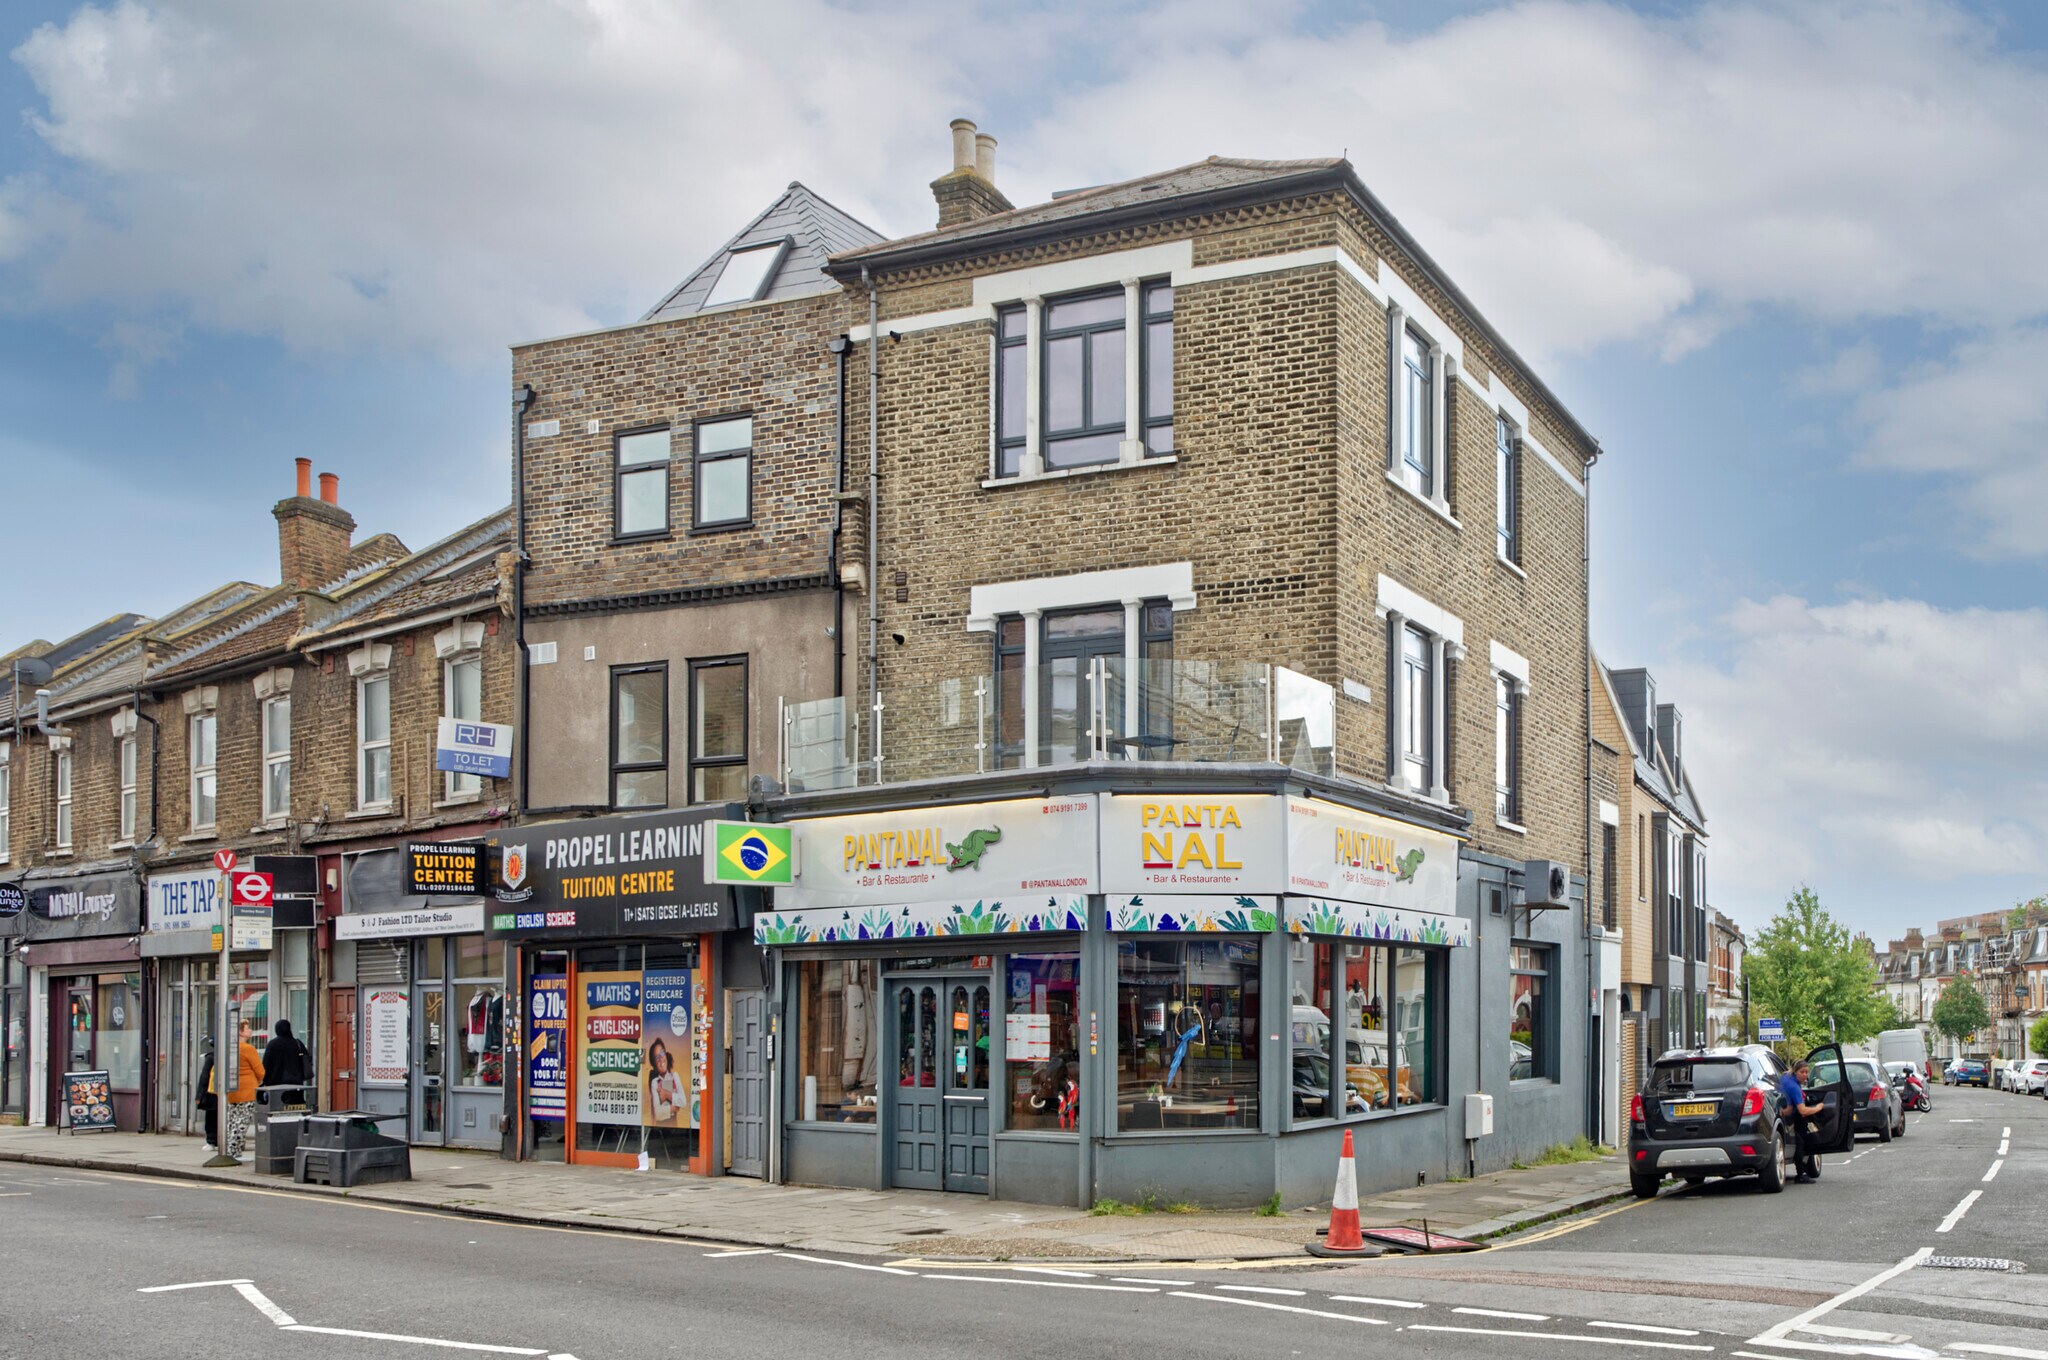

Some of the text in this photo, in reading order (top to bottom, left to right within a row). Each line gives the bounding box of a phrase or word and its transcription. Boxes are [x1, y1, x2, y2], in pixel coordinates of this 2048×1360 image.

[458, 725, 494, 746] RH
[454, 753, 494, 767] TO LET
[1050, 805, 1060, 813] 074
[1142, 804, 1242, 828] PANTA
[410, 844, 475, 855] PROPEL LEARNING
[546, 823, 703, 870] PROPEL LEARNIN
[843, 827, 947, 872] PANTANAL
[1142, 832, 1243, 869] NAL
[1335, 826, 1398, 875] PANTANAL
[219, 853, 233, 869] V
[414, 854, 475, 870] TUITION
[414, 869, 474, 884] CENTRE
[862, 872, 929, 890] Bar & Restaurante
[1029, 877, 1088, 889] @PANTANALLONDON
[1153, 874, 1232, 883] Bar & Restaurante
[1346, 871, 1354, 882] Bar
[562, 869, 675, 900] TUITION CENTRE
[162, 882, 188, 916] THE
[191, 879, 216, 914] TAP
[49, 891, 116, 921] MOHA Lounge
[361, 918, 366, 928] S
[372, 917, 376, 927] J
[378, 915, 400, 926] Fashion
[401, 914, 413, 925] LTD
[414, 914, 431, 924] Tailor
[432, 912, 453, 923] Studio
[493, 910, 576, 929] MATHS ENGLISH SCIENCE
[646, 976, 685, 986] REGISTERED
[596, 984, 631, 1002] MATHS
[646, 989, 683, 1000] CHILDCARE
[646, 1003, 671, 1013] CENTRE
[593, 1020, 634, 1035] ENGLISH
[541, 1057, 558, 1069] BOOK
[591, 1051, 636, 1068] SCIENCE
[534, 1069, 566, 1080] YOUR FEE
[593, 1090, 608, 1100] 0207
[593, 1103, 608, 1113] 0744
[1674, 1105, 1696, 1115] BT62
